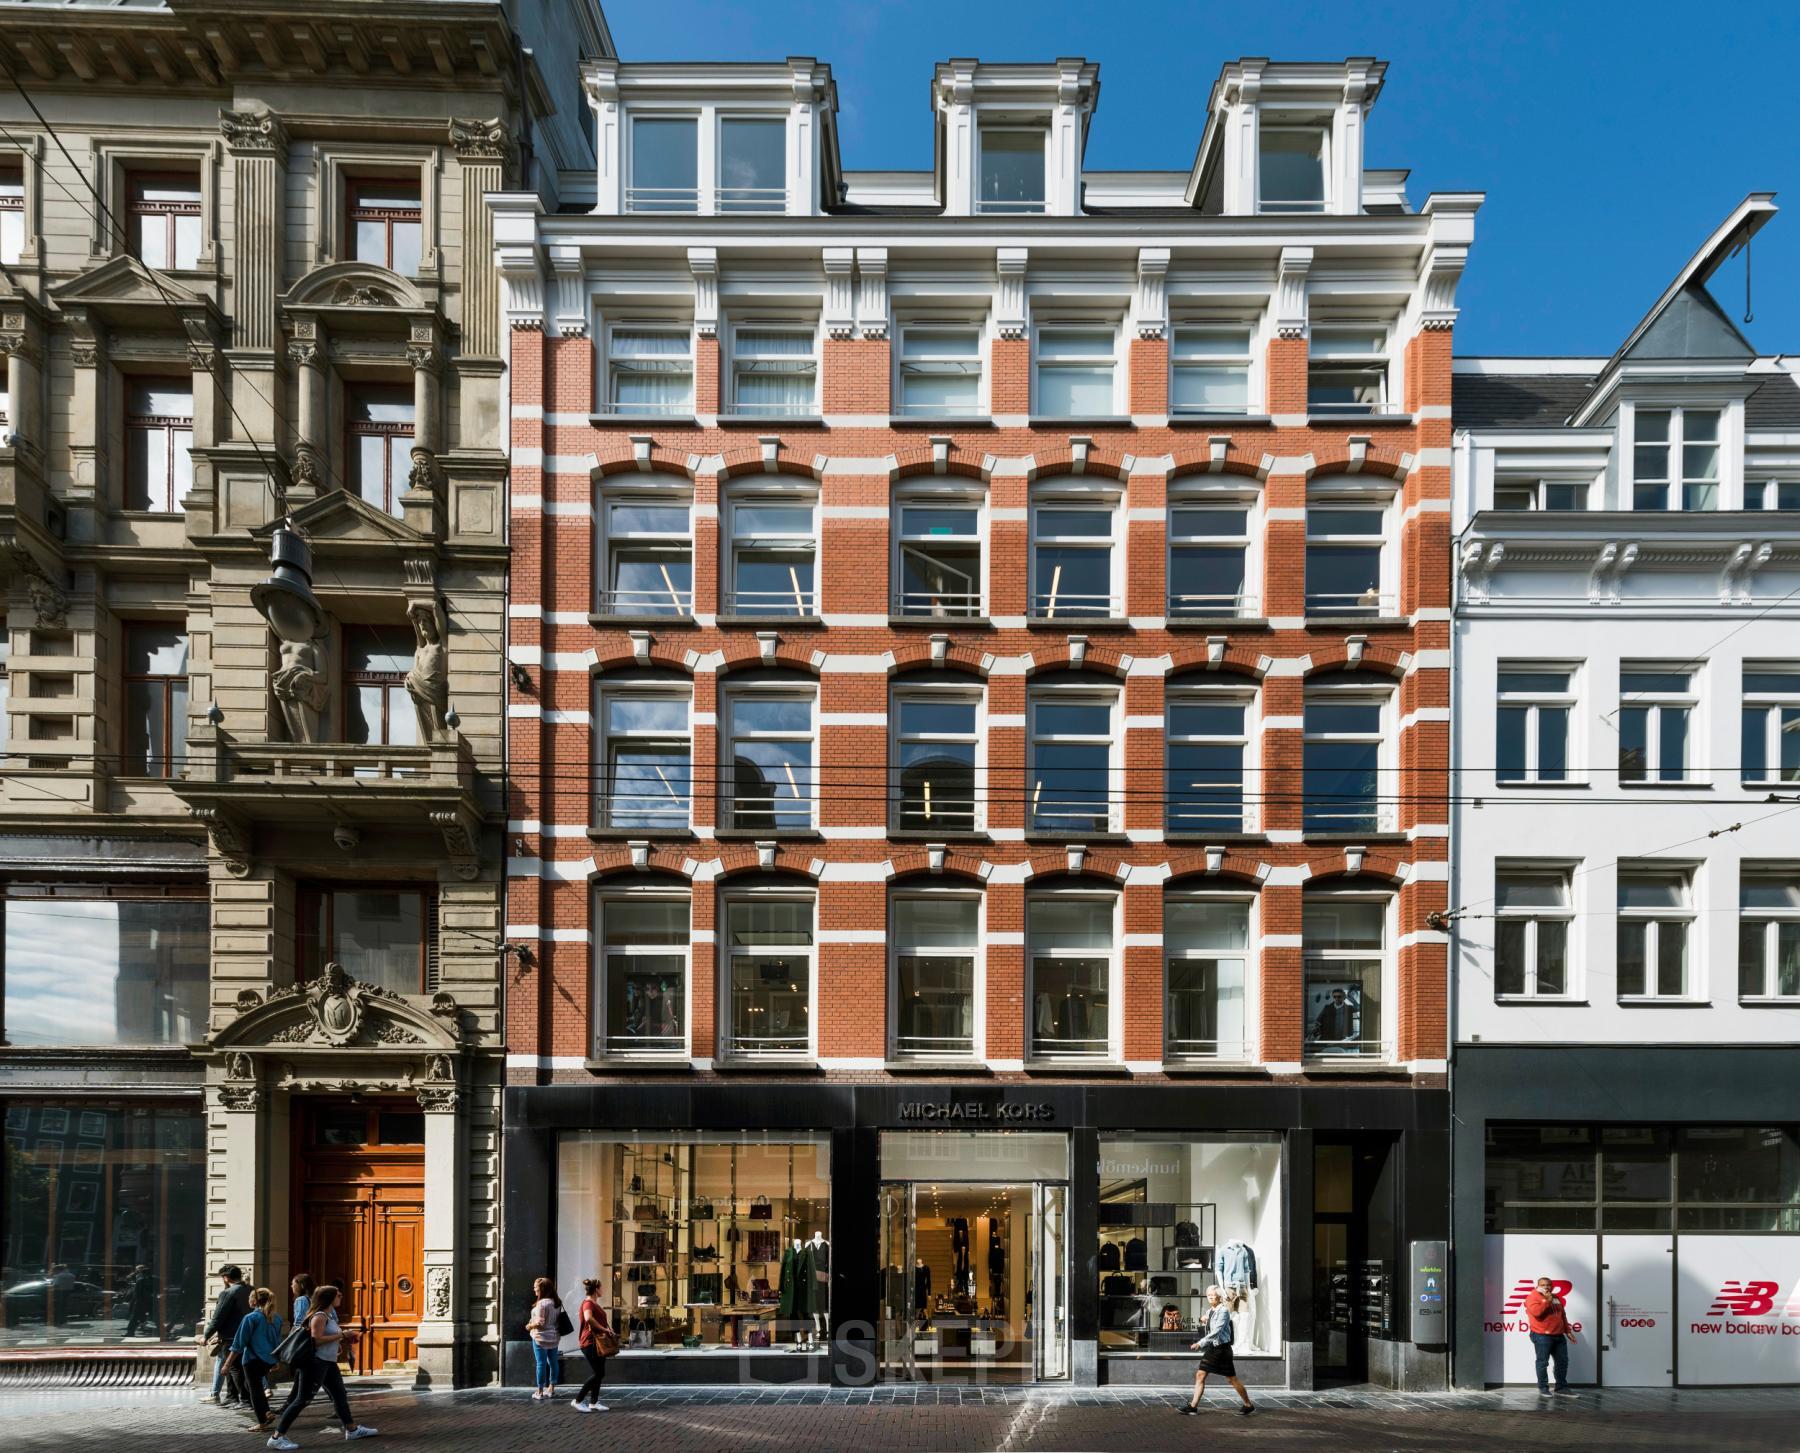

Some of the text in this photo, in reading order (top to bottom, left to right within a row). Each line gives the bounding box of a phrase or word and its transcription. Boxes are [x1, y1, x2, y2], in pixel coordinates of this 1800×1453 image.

[899, 1102, 1053, 1119] MICHAEL KORS
[1484, 1321, 1515, 1333] new
[1691, 1322, 1722, 1334] new
